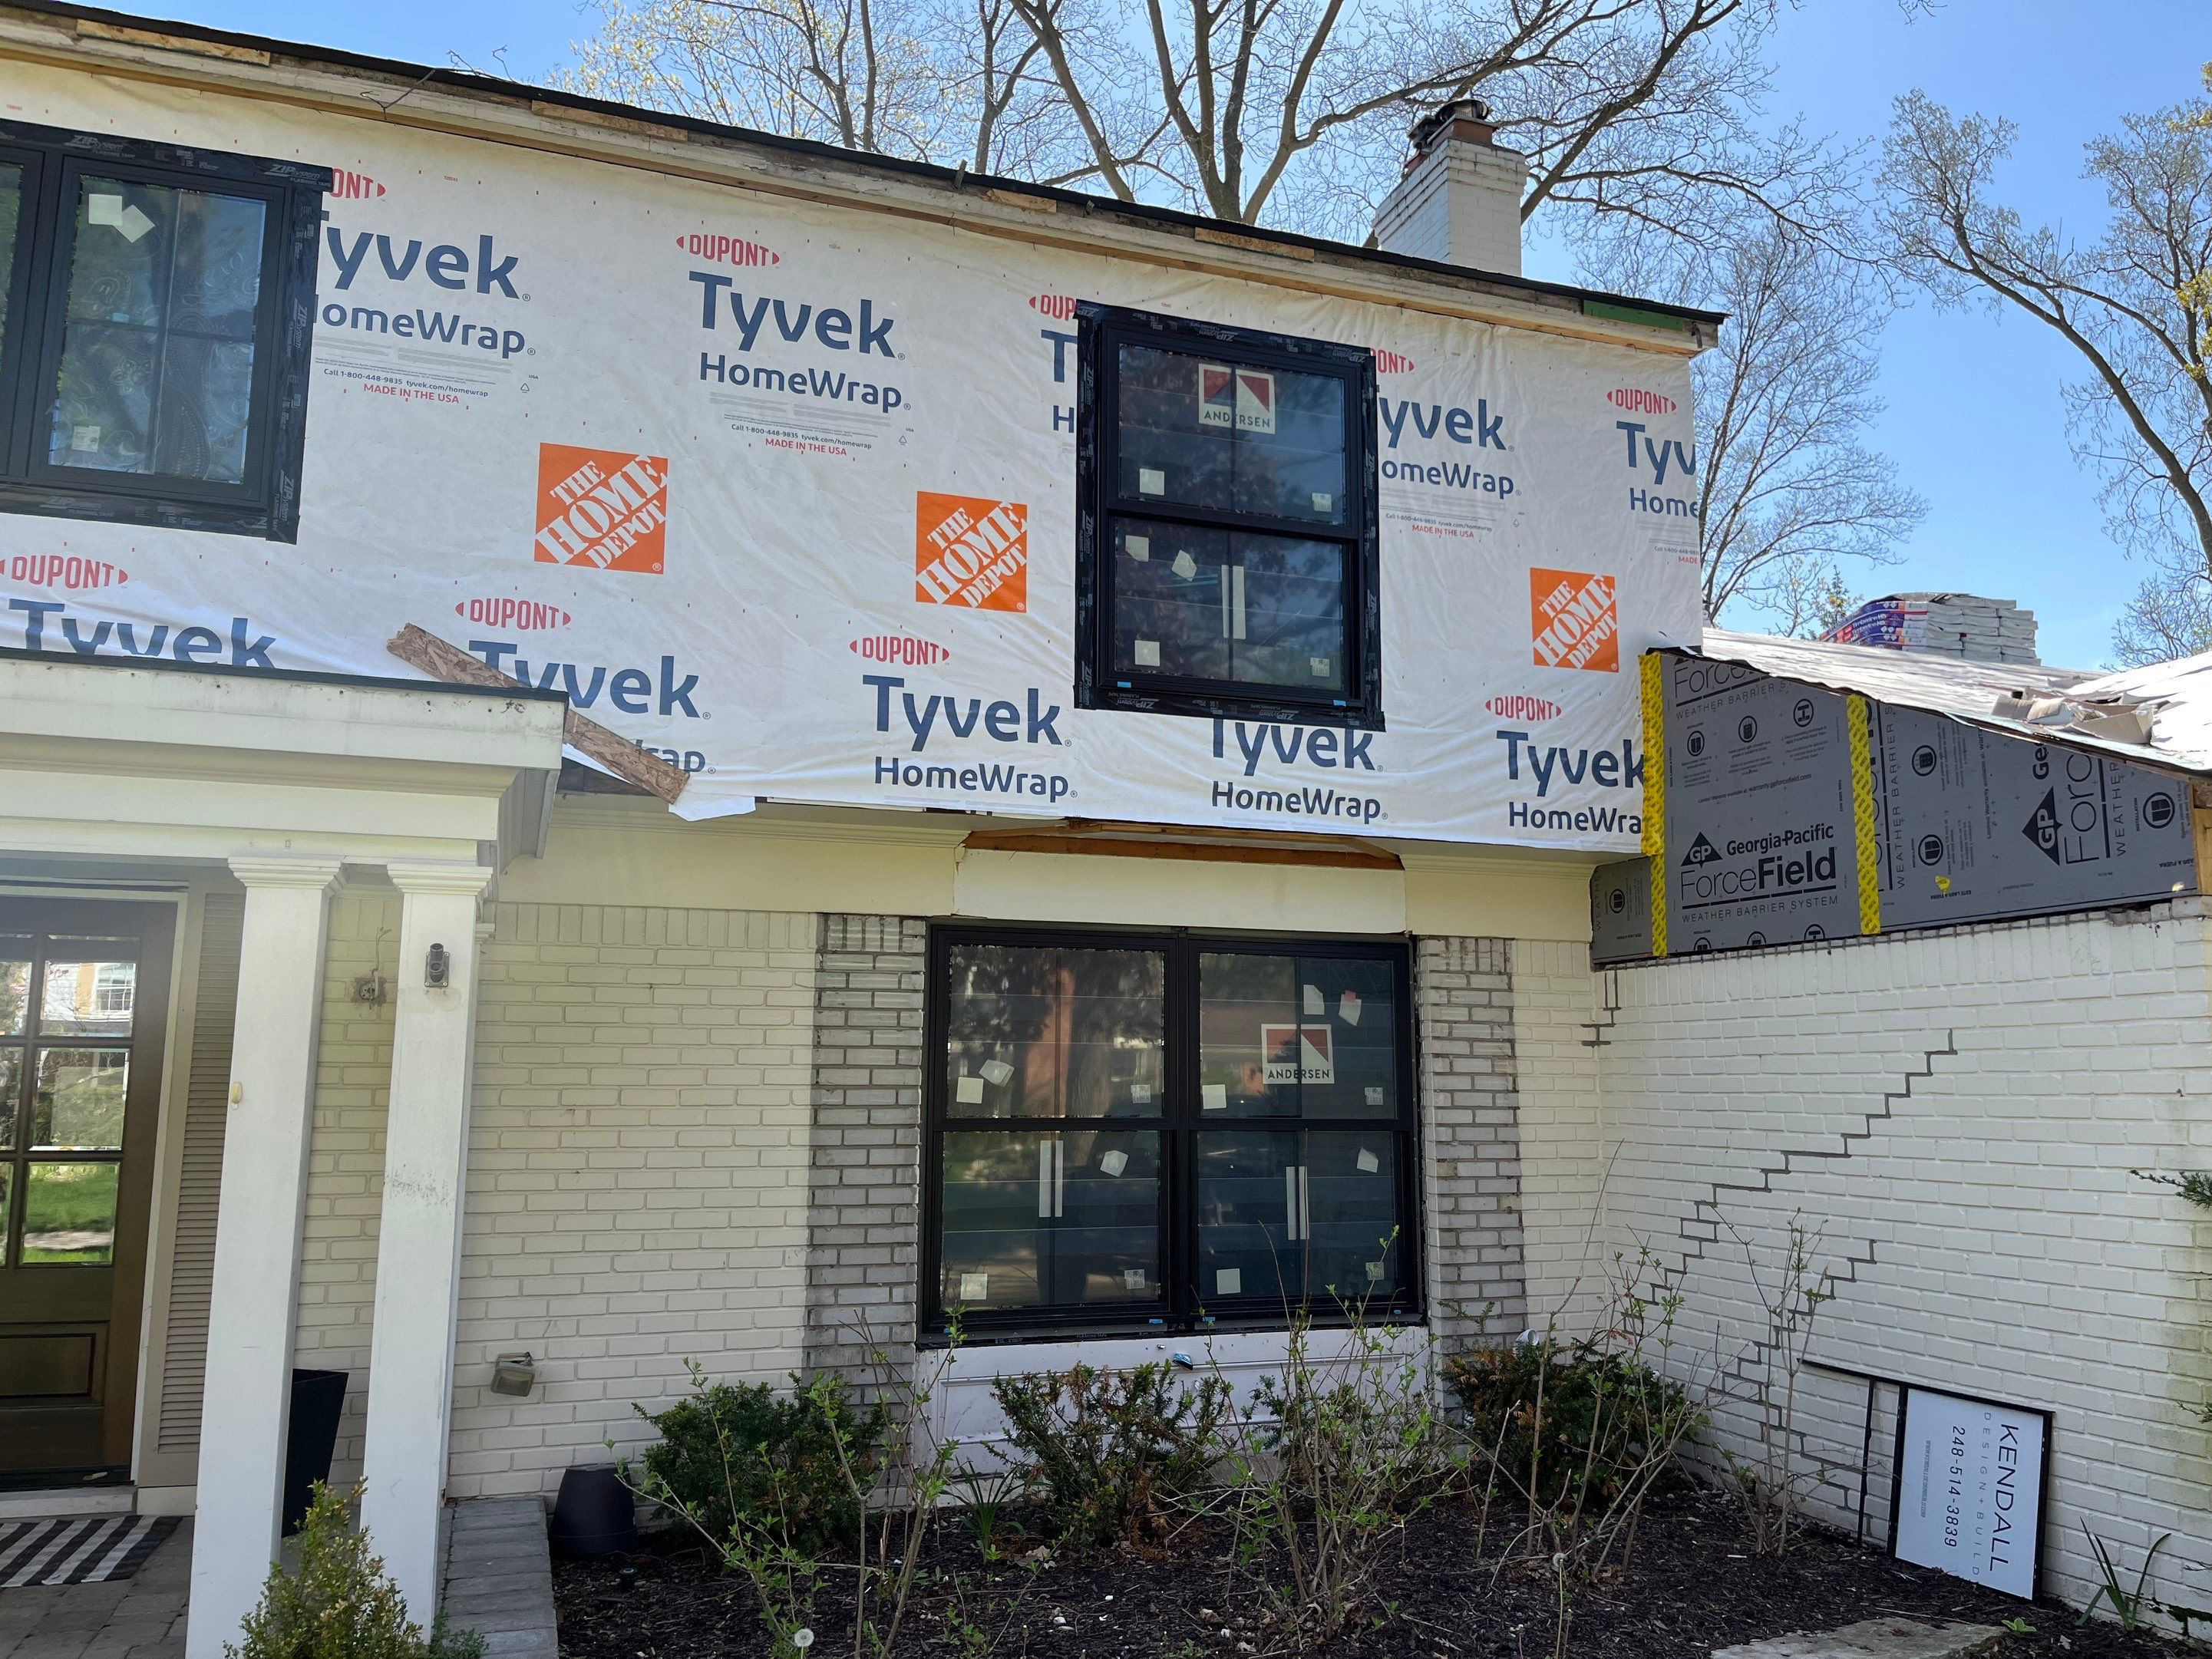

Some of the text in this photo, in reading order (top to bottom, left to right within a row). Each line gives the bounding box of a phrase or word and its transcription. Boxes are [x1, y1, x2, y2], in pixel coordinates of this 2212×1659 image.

[331, 168, 373, 199] ONT
[327, 226, 520, 299] yvek
[689, 234, 769, 267] DUPONT
[688, 270, 896, 358] Tyvek
[1041, 295, 1075, 322] DUP
[322, 303, 525, 358] omeWrap
[1370, 348, 1406, 374] ONT
[341, 371, 403, 384] 1-800-448-9835
[406, 380, 488, 397] tyvek.com/homewrap
[364, 384, 459, 404] MADE IN THE USA
[700, 352, 902, 414] HomeWrap
[1616, 389, 1669, 414] DUPONT
[745, 426, 798, 438] 1-800-448-9835
[801, 434, 872, 450] tyvek.com/homewrap
[1379, 397, 1507, 450] yvek
[765, 438, 794, 449] MADE
[808, 444, 826, 453] THE
[829, 446, 847, 456] USA
[1616, 421, 1696, 485] Tyv
[550, 460, 606, 506] THE
[1382, 460, 1514, 500] omeWrap
[536, 454, 668, 565] HOME
[1629, 488, 1699, 518] Home
[585, 500, 666, 570] DEPOT
[926, 506, 975, 550] THE
[1412, 524, 1433, 534] MADE
[11, 554, 114, 589] DUPONT
[916, 501, 1028, 605] HOME
[959, 543, 1028, 608] DEPOT
[470, 598, 560, 630] DUPONT
[1533, 574, 1616, 668] HOME
[1540, 580, 1576, 620] THE
[8, 599, 276, 668] Tyvek
[862, 636, 939, 665] DUPONT
[1566, 610, 1618, 669] DEPOT
[862, 674, 1061, 752] Tyvek
[1494, 696, 1553, 721] DUPONT
[1676, 699, 1723, 719] WEATHER
[1728, 683, 1774, 704] BARRIER
[875, 756, 1068, 803] HomeWrap
[1497, 730, 1644, 797] Tyvek
[1887, 724, 1899, 797] BARRIER
[1212, 781, 1381, 824] HomeWrap
[1509, 801, 1642, 834] HomeWra
[1726, 823, 1834, 856] Georgia-Pacific
[1893, 806, 1905, 889] WEATHER
[2036, 808, 2055, 849] GP
[1681, 846, 1837, 900] ForceField
[1689, 844, 1712, 861] GP
[1682, 895, 1838, 923] WEATHER BARRIER SYSTEM
[1268, 1069, 1329, 1079] ANDERSEN
[1944, 1426, 1966, 1548] 248-514-3839
[1989, 1423, 2019, 1572] KENDALL
